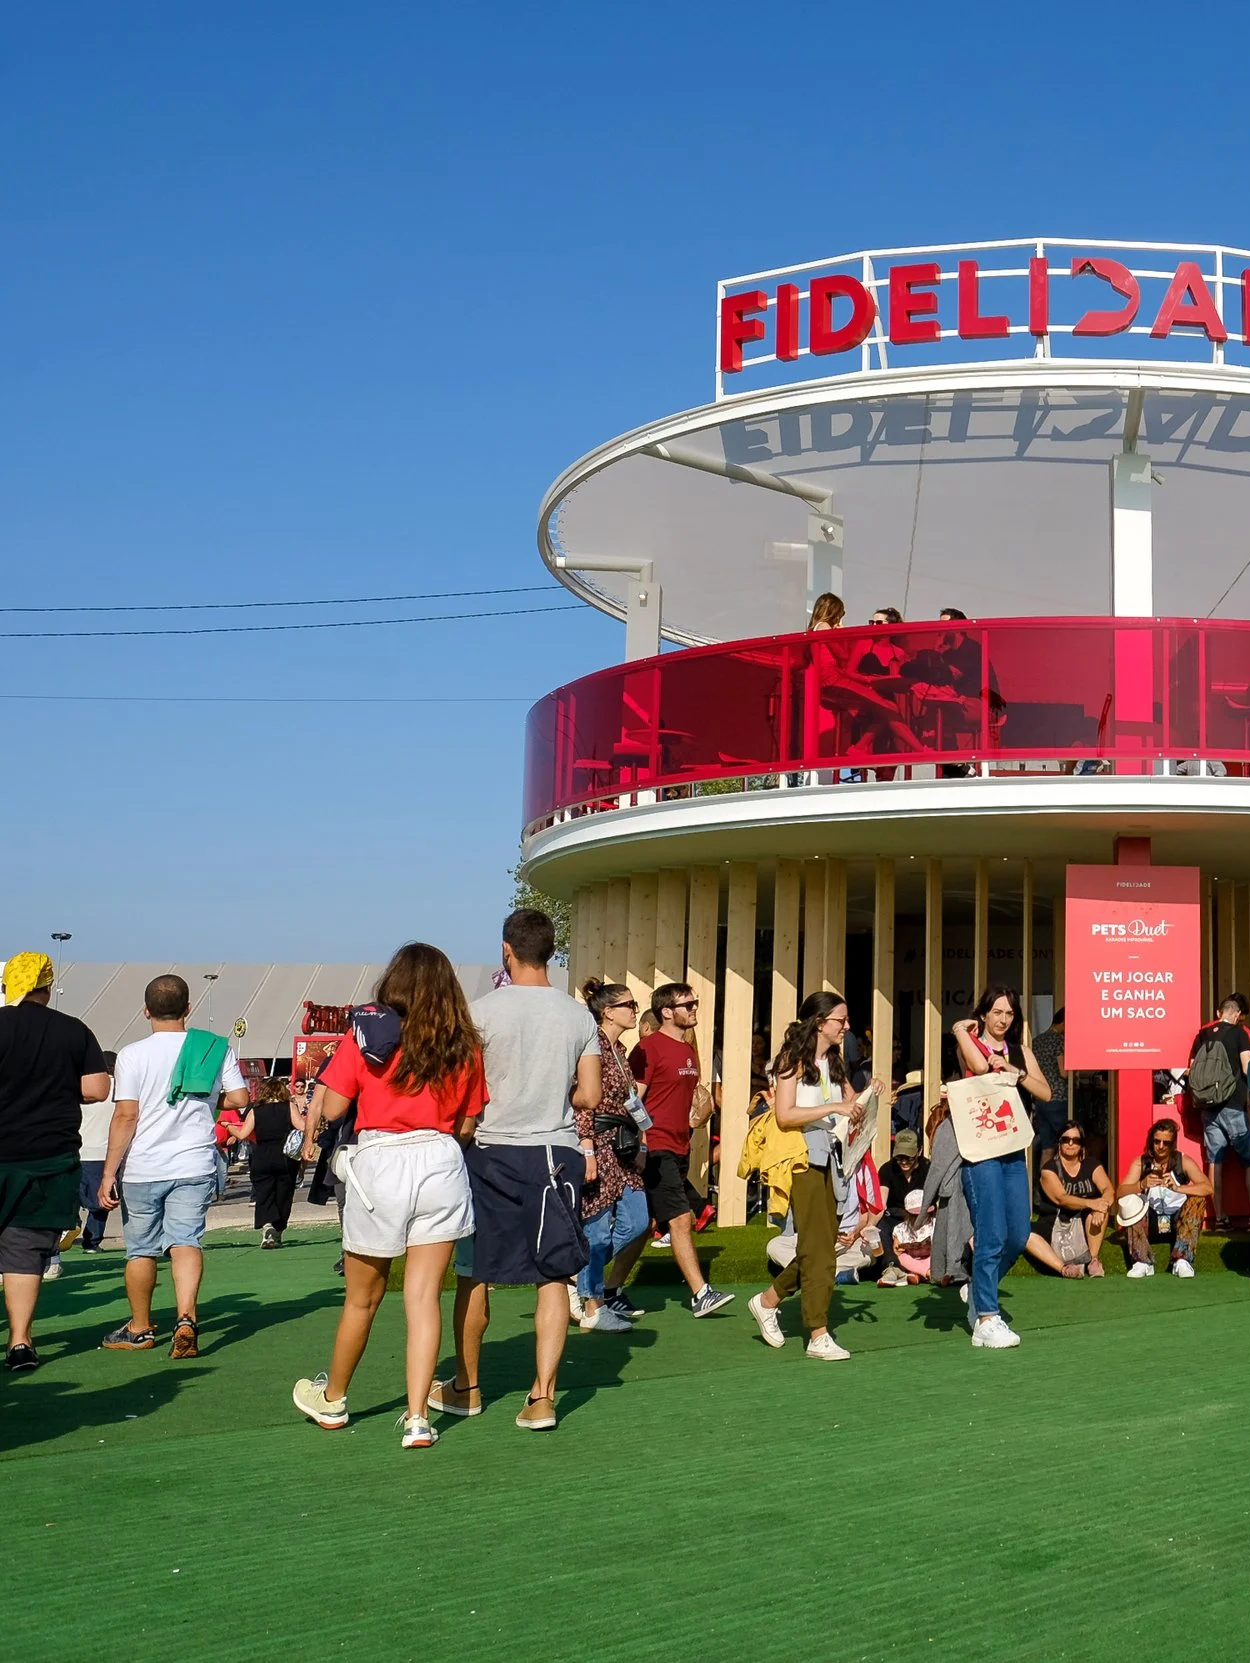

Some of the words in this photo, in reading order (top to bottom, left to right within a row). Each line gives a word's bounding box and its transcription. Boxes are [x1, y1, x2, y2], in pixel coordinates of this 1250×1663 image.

[1091, 924, 1126, 936] PETS
[1128, 919, 1175, 937] Duet
[1093, 971, 1123, 983] VEM
[1126, 971, 1174, 983] JOGAR
[1101, 989, 1109, 1001] E
[1113, 989, 1166, 1001] GANHA
[1101, 1007, 1123, 1019] UM
[1127, 1007, 1166, 1019] SACO
